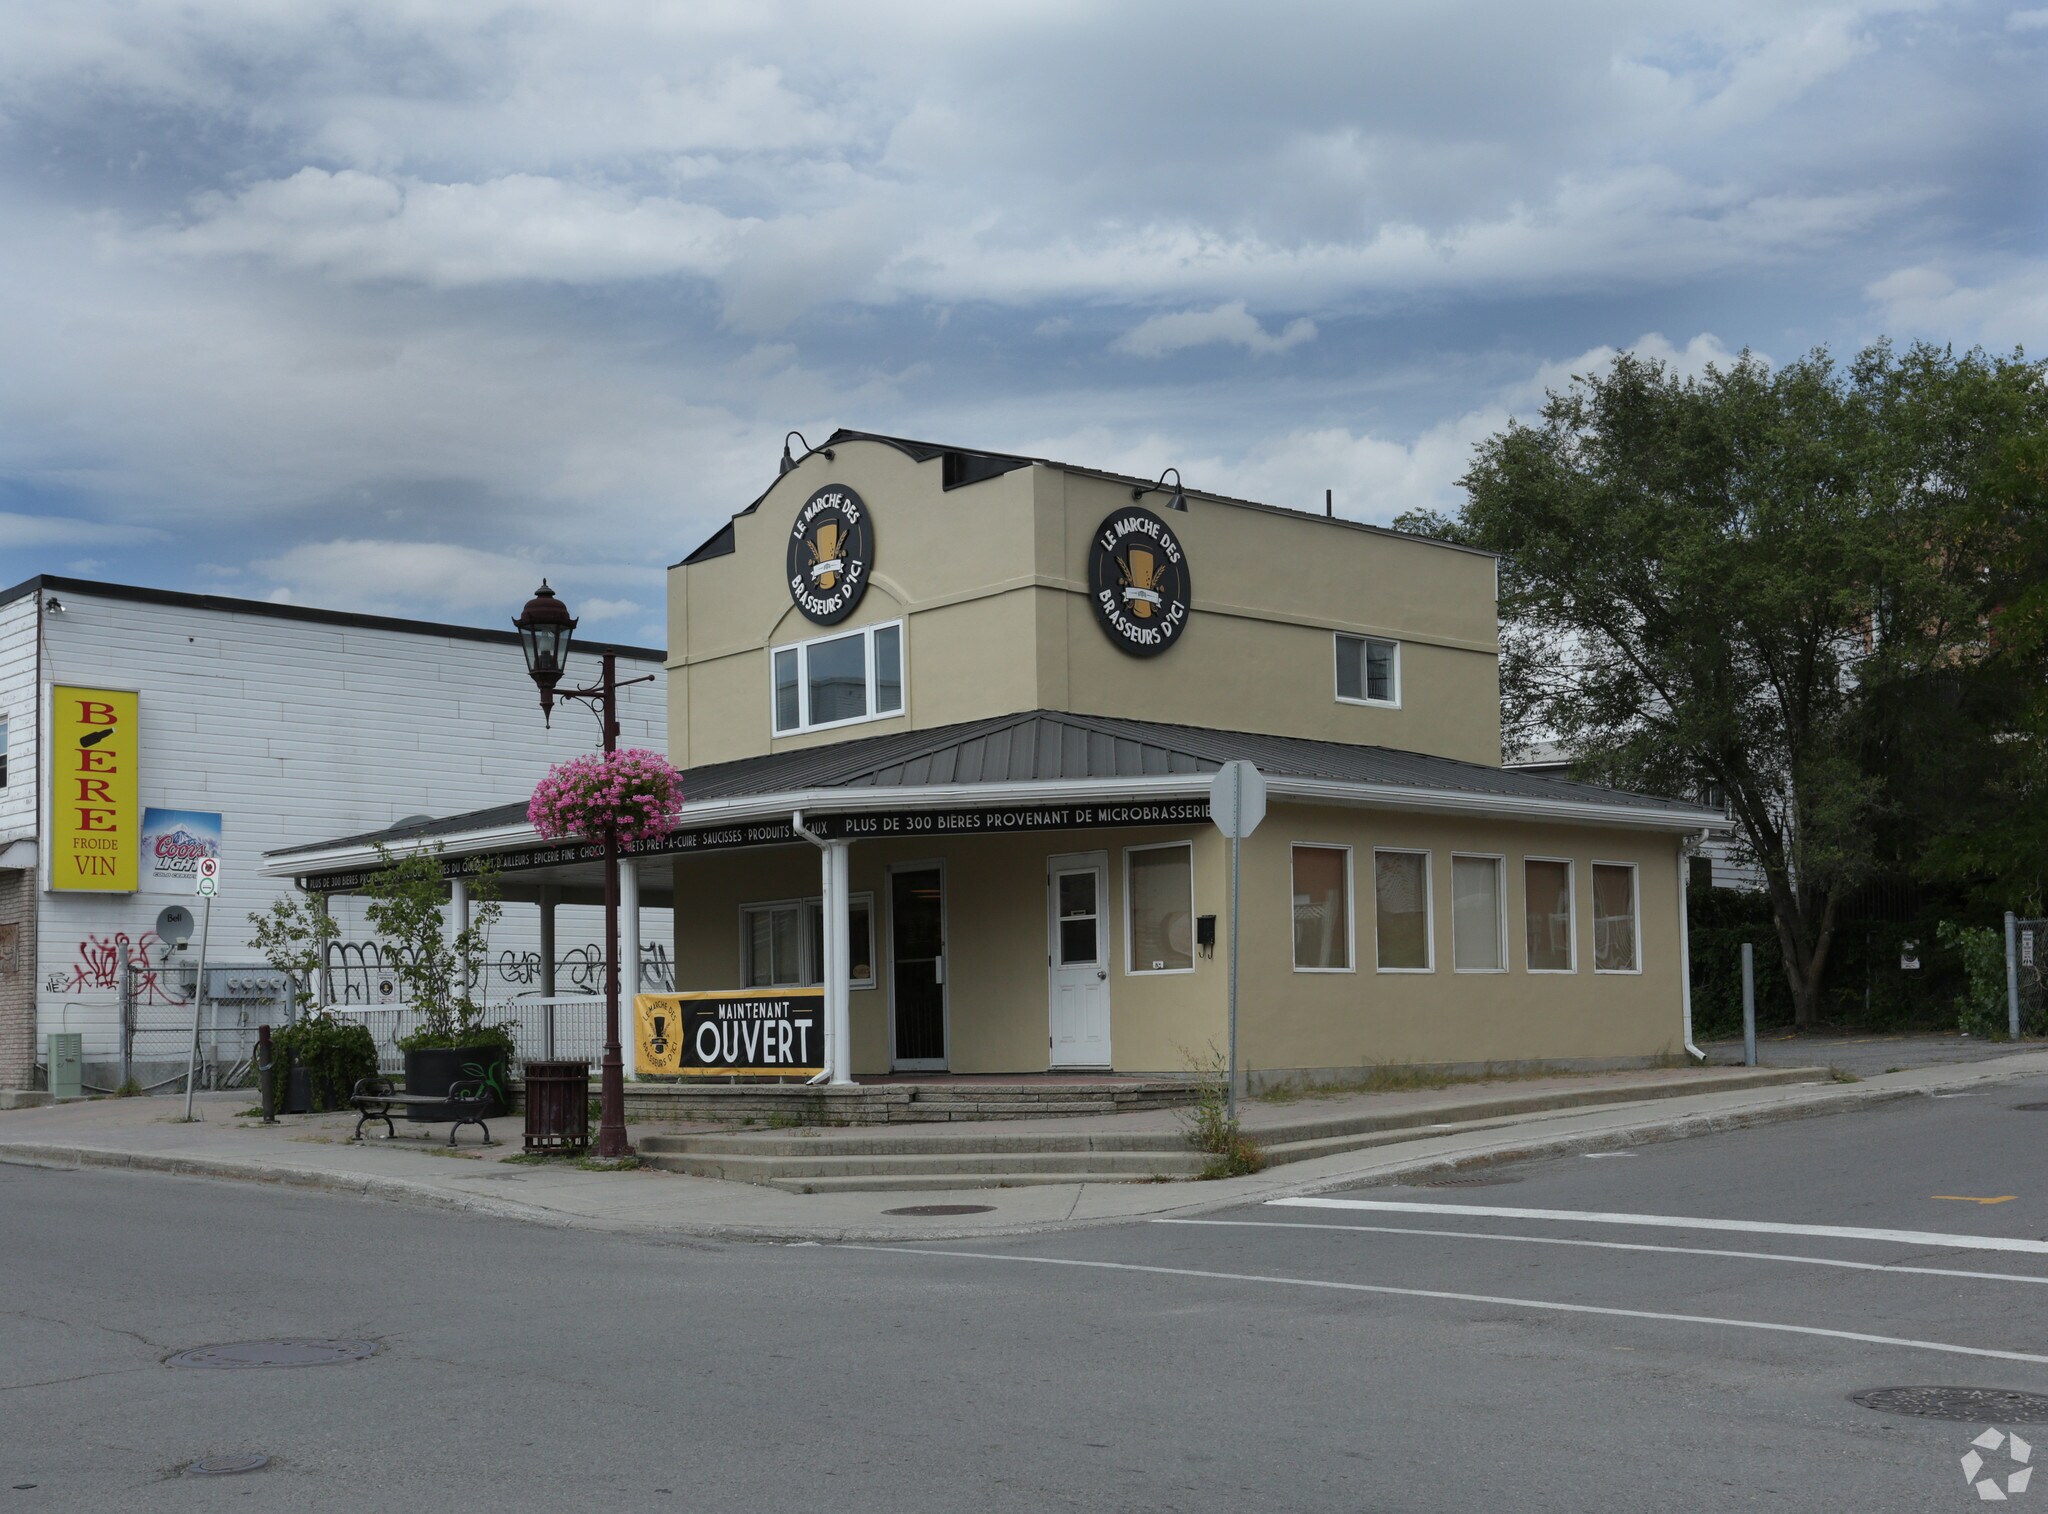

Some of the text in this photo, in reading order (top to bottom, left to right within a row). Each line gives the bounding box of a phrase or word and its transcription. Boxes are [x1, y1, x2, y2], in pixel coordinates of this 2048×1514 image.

[793, 520, 807, 539] LE
[842, 499, 860, 524] DES
[1101, 530, 1117, 551] LE
[1160, 533, 1181, 563] DES
[791, 574, 842, 615] BRASSEURS
[1099, 589, 1161, 644] BRASSEURS
[846, 819, 877, 832] PLUS
[883, 817, 900, 830] DE
[906, 816, 932, 830] 300
[986, 810, 1069, 827] PROVENANT
[1076, 809, 1092, 823] DE
[73, 837, 118, 850] FROIDE
[155, 835, 207, 859] Coors
[310, 877, 322, 889] PLUS
[322, 877, 330, 888] DE
[331, 875, 341, 887] 300
[452, 862, 460, 874] DU
[562, 849, 575, 860] FINE
[627, 840, 644, 853] ETS
[703, 829, 742, 845] SAUCISSES
[748, 825, 790, 841] PRODUITS
[793, 821, 827, 837] LCAUX
[75, 855, 116, 876] VIN
[167, 913, 182, 923] Bell
[642, 1010, 651, 1022] LE
[668, 1006, 677, 1021] DES
[718, 1001, 790, 1020] MAINTENANT
[696, 1019, 813, 1063] OUVERT
